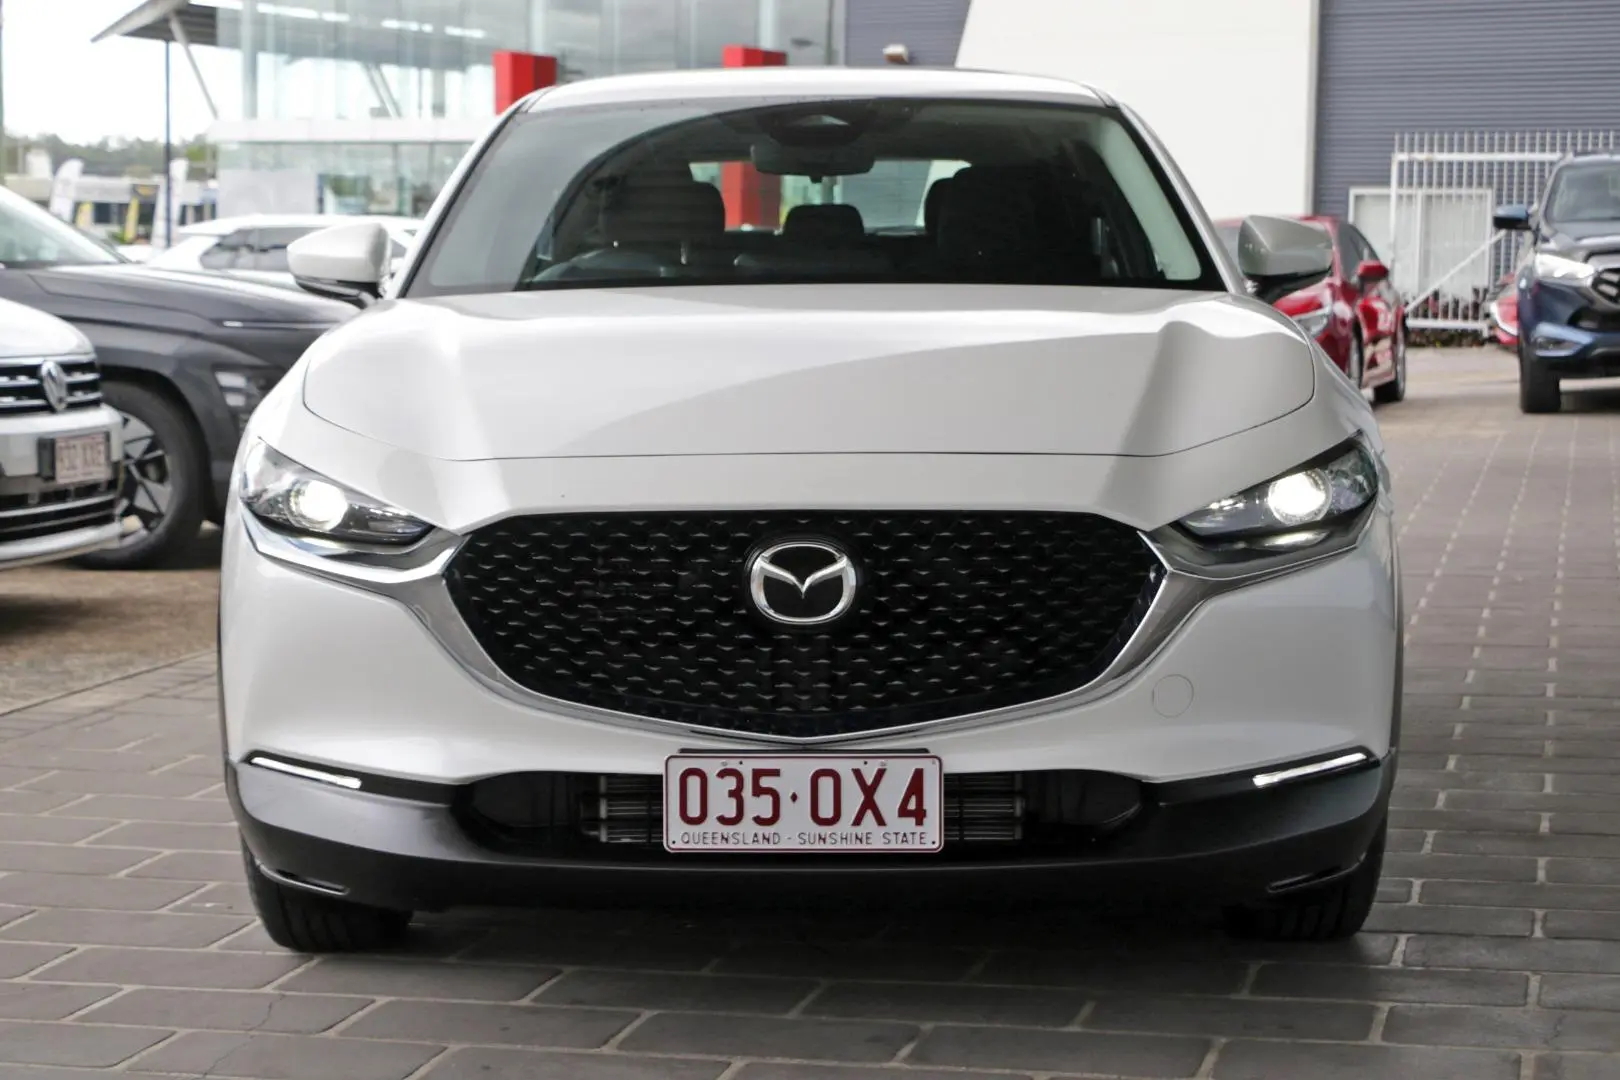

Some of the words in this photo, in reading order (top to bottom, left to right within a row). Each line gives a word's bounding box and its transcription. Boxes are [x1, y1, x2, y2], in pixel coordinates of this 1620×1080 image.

[681, 831, 780, 846] QUEENSLAND
[797, 831, 873, 846] SUNSHINE
[882, 831, 927, 845] STATE
